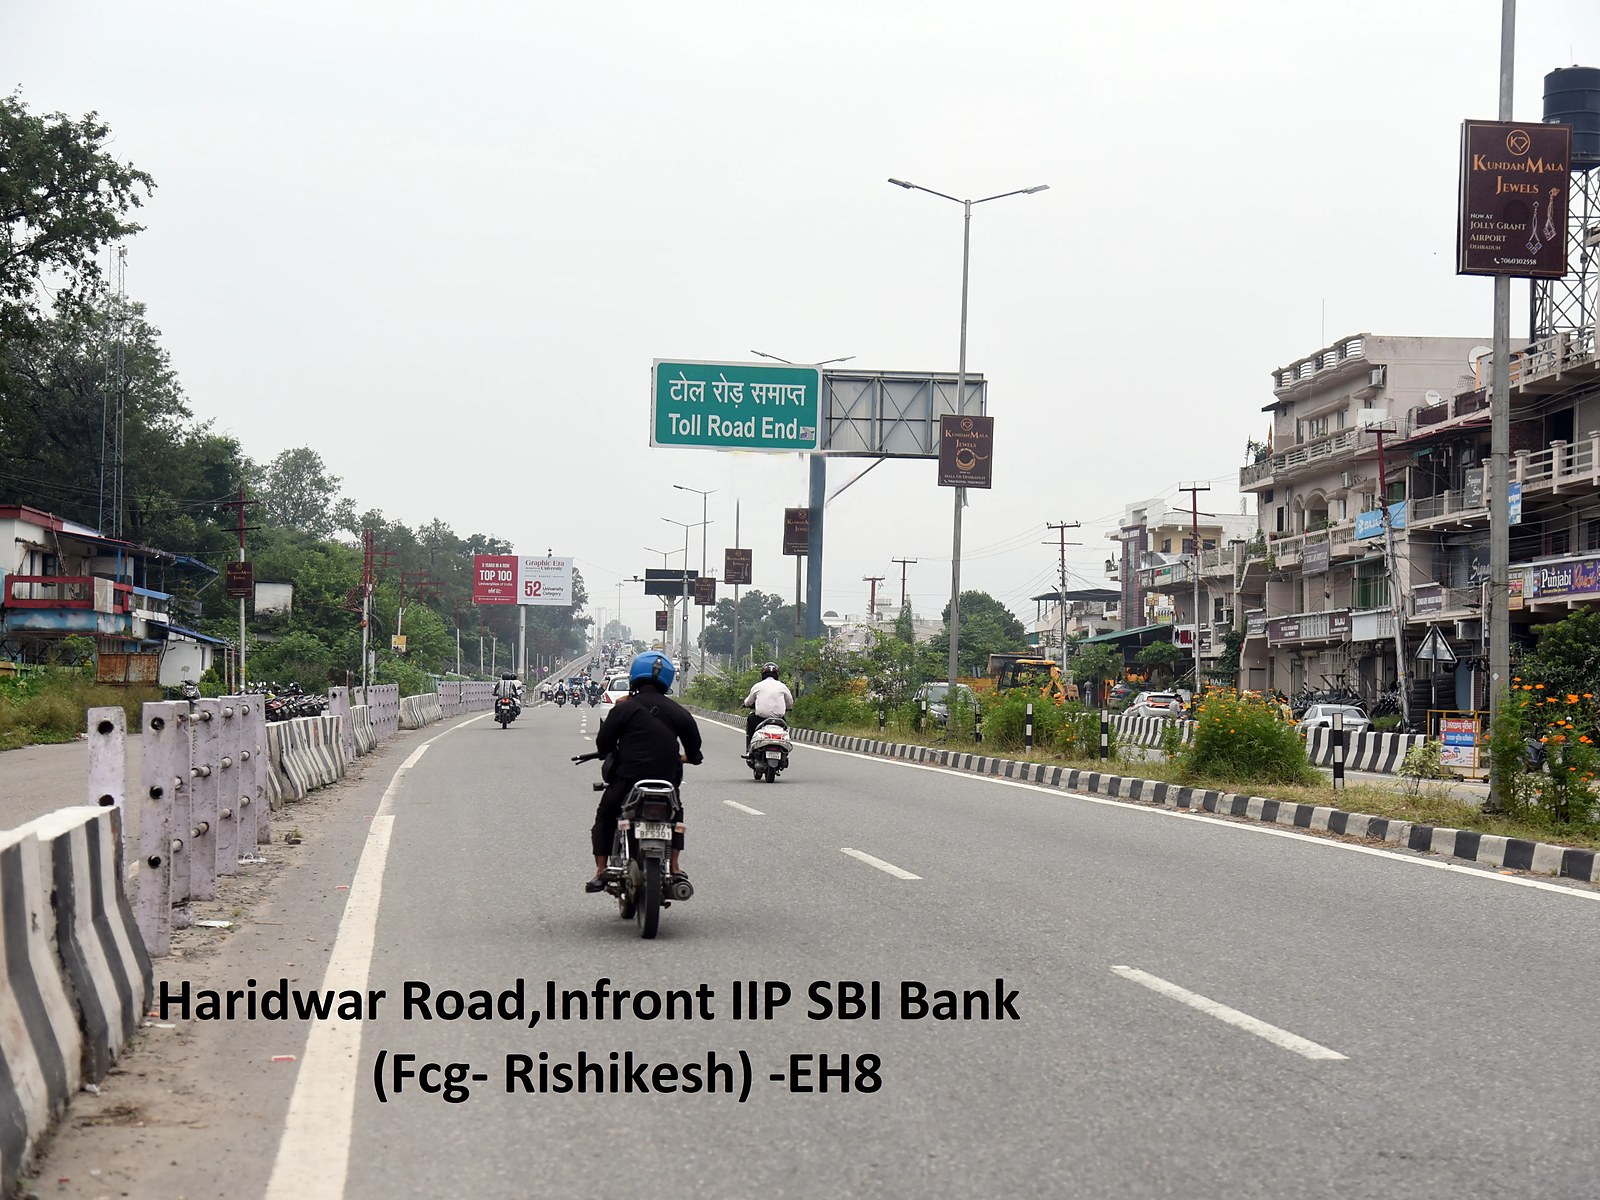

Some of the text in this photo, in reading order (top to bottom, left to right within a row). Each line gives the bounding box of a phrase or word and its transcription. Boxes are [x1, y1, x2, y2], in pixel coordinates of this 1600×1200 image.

[669, 371, 806, 408] टोल रोड़ समाप्त
[668, 413, 798, 439] Toll Road End
[525, 559, 551, 568] Graphic
[480, 570, 496, 581] TOP
[498, 570, 512, 581] 100
[1541, 568, 1572, 589] Punjabi
[524, 580, 542, 597] 52
